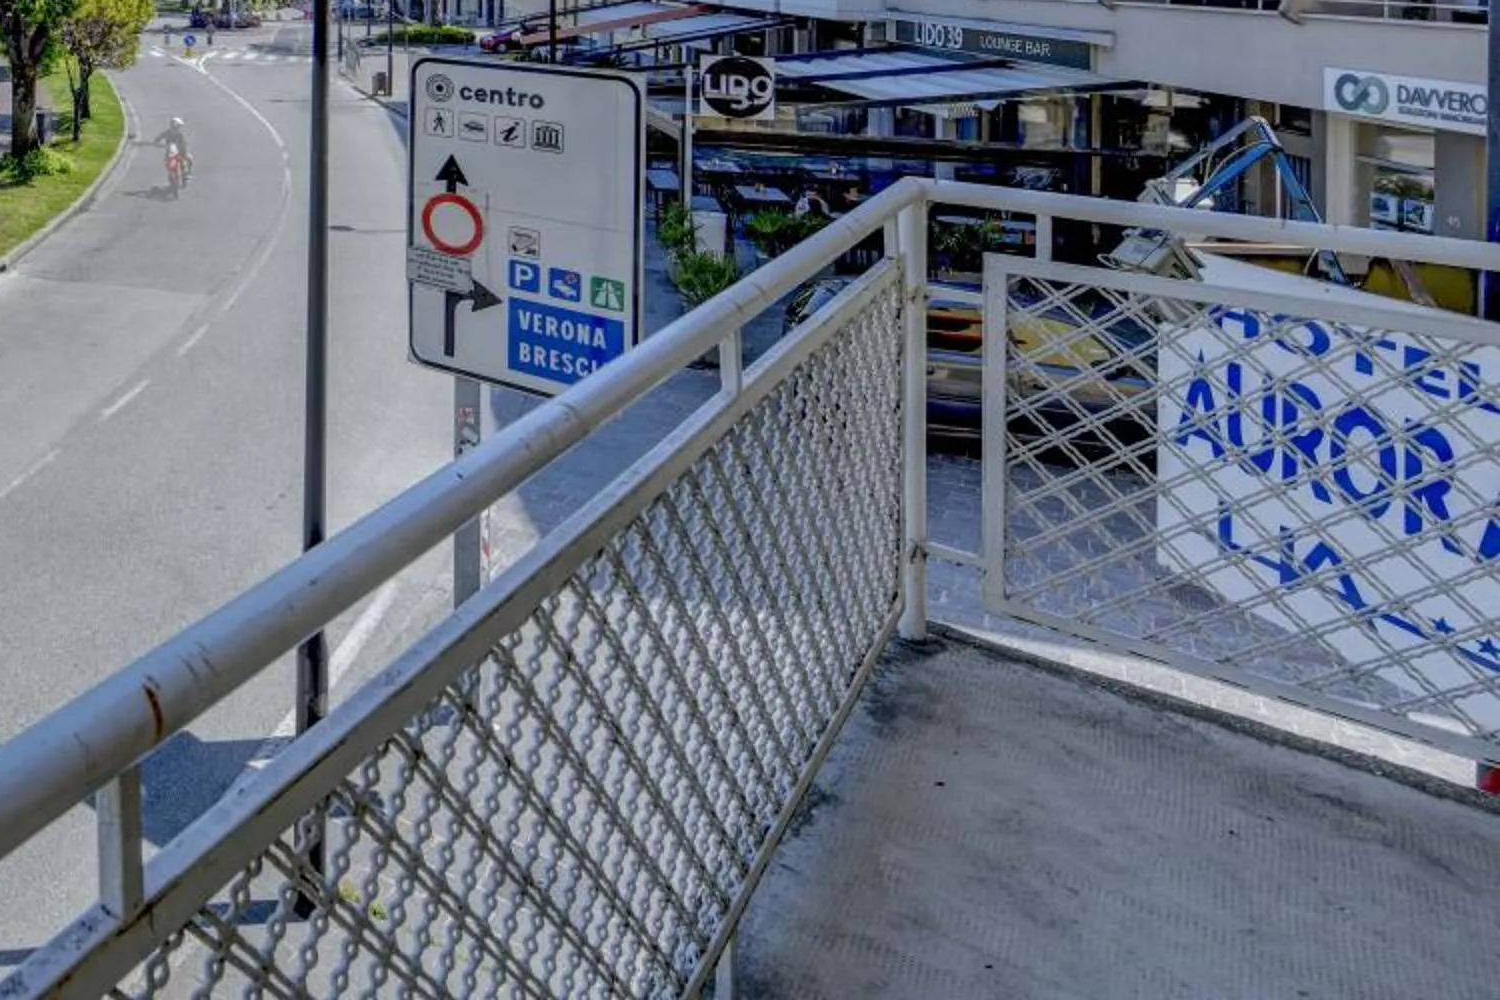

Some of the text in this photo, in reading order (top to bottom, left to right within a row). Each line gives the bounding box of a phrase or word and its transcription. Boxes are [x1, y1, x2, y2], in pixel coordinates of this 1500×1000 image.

[914, 21, 963, 49] LIDO 39
[979, 35, 1051, 57] LOUNGE BAR
[459, 86, 545, 109] centro
[514, 263, 534, 287] P
[518, 309, 607, 350] VERONA
[519, 341, 600, 378] BRESCI
